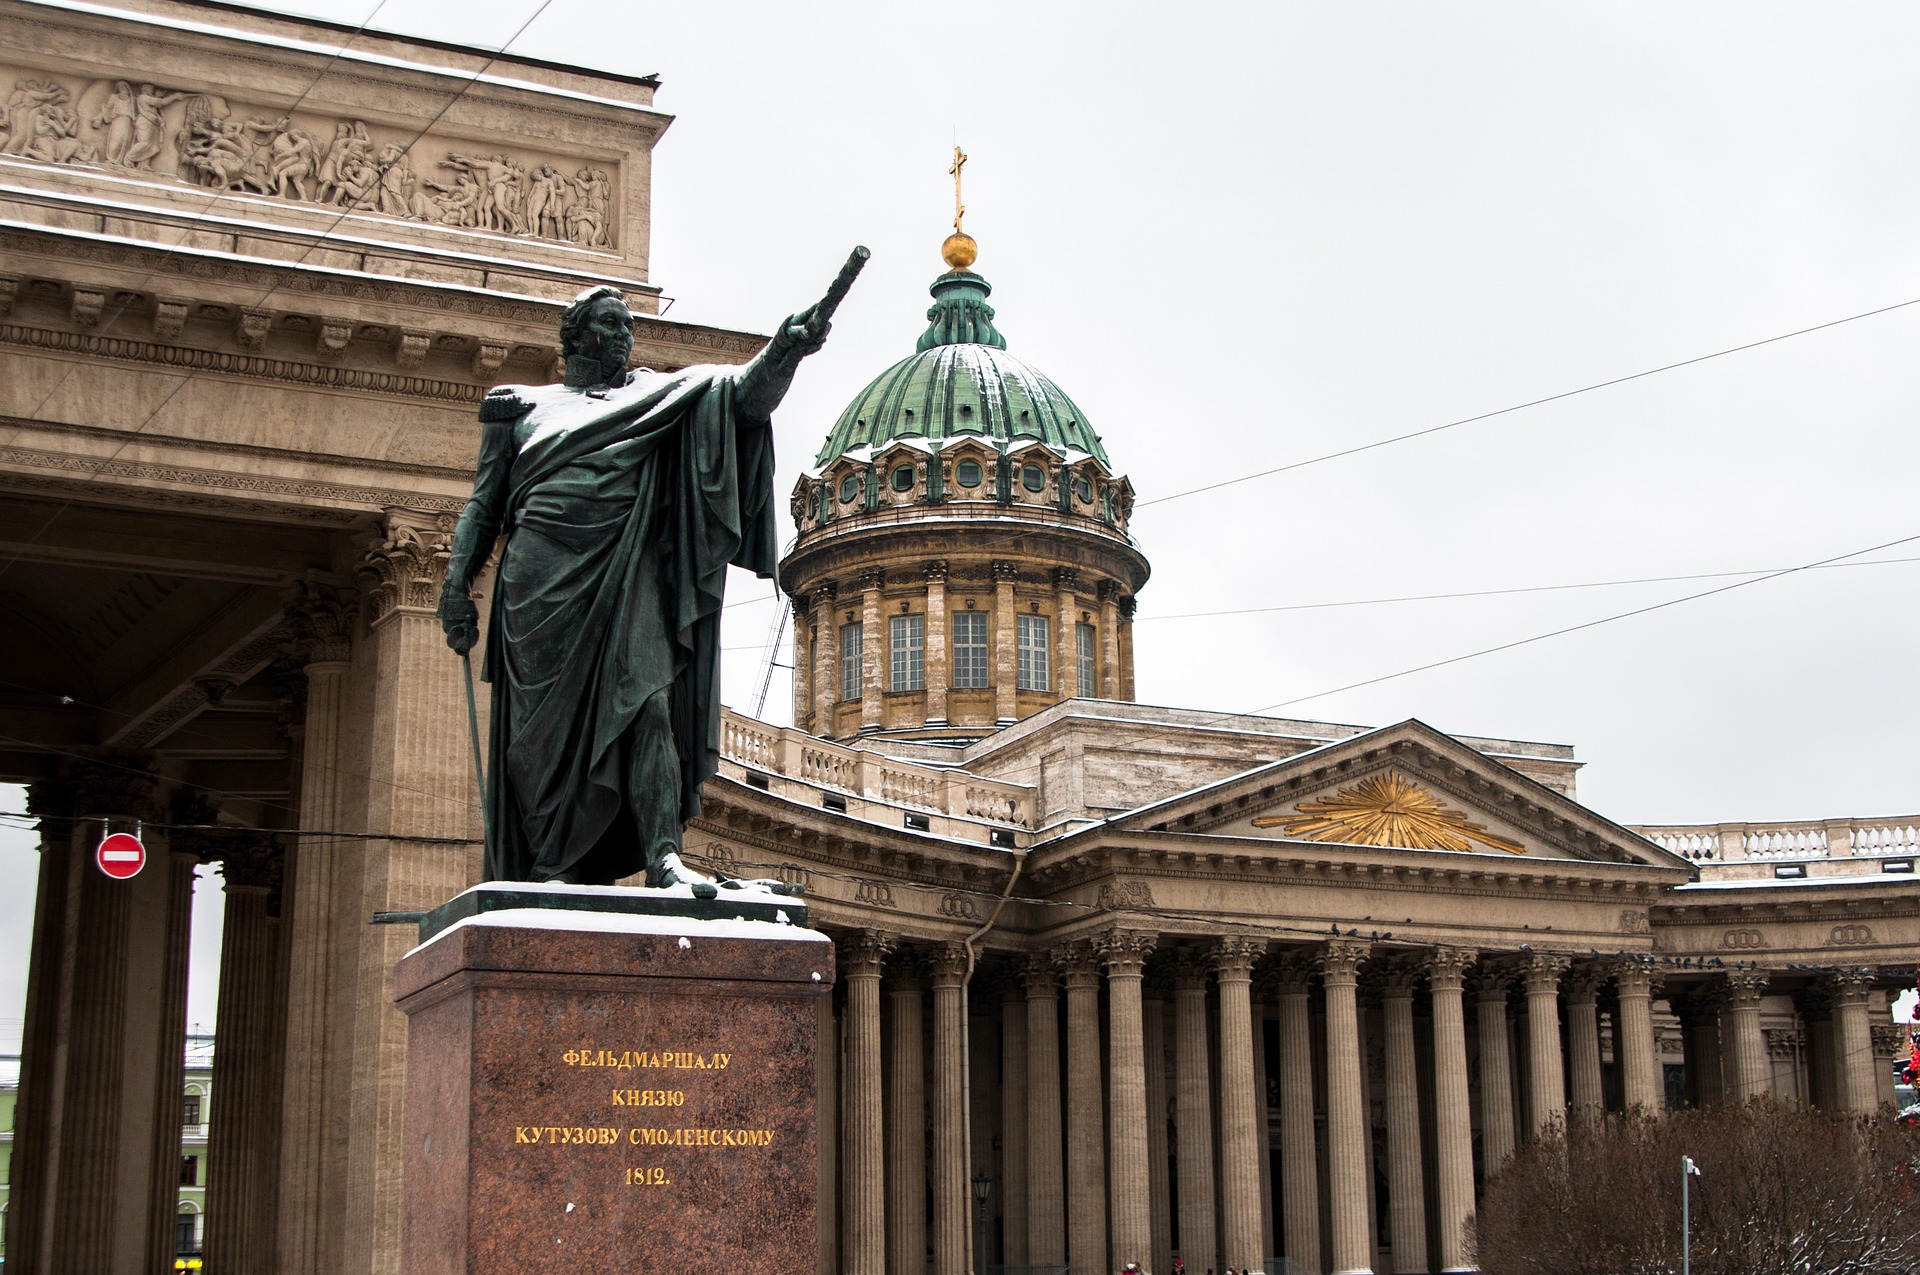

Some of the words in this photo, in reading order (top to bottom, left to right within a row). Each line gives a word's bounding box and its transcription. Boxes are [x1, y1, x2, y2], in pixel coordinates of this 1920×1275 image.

[562, 1049, 732, 1070] ФЕЛЬДМАРШАЛУ
[612, 1089, 685, 1107] КНЯЗЮ
[515, 1126, 621, 1144] КУТУЗОВУ
[629, 1128, 776, 1146] СМОЛЕНСКОМУ
[624, 1168, 671, 1185] 1812.
